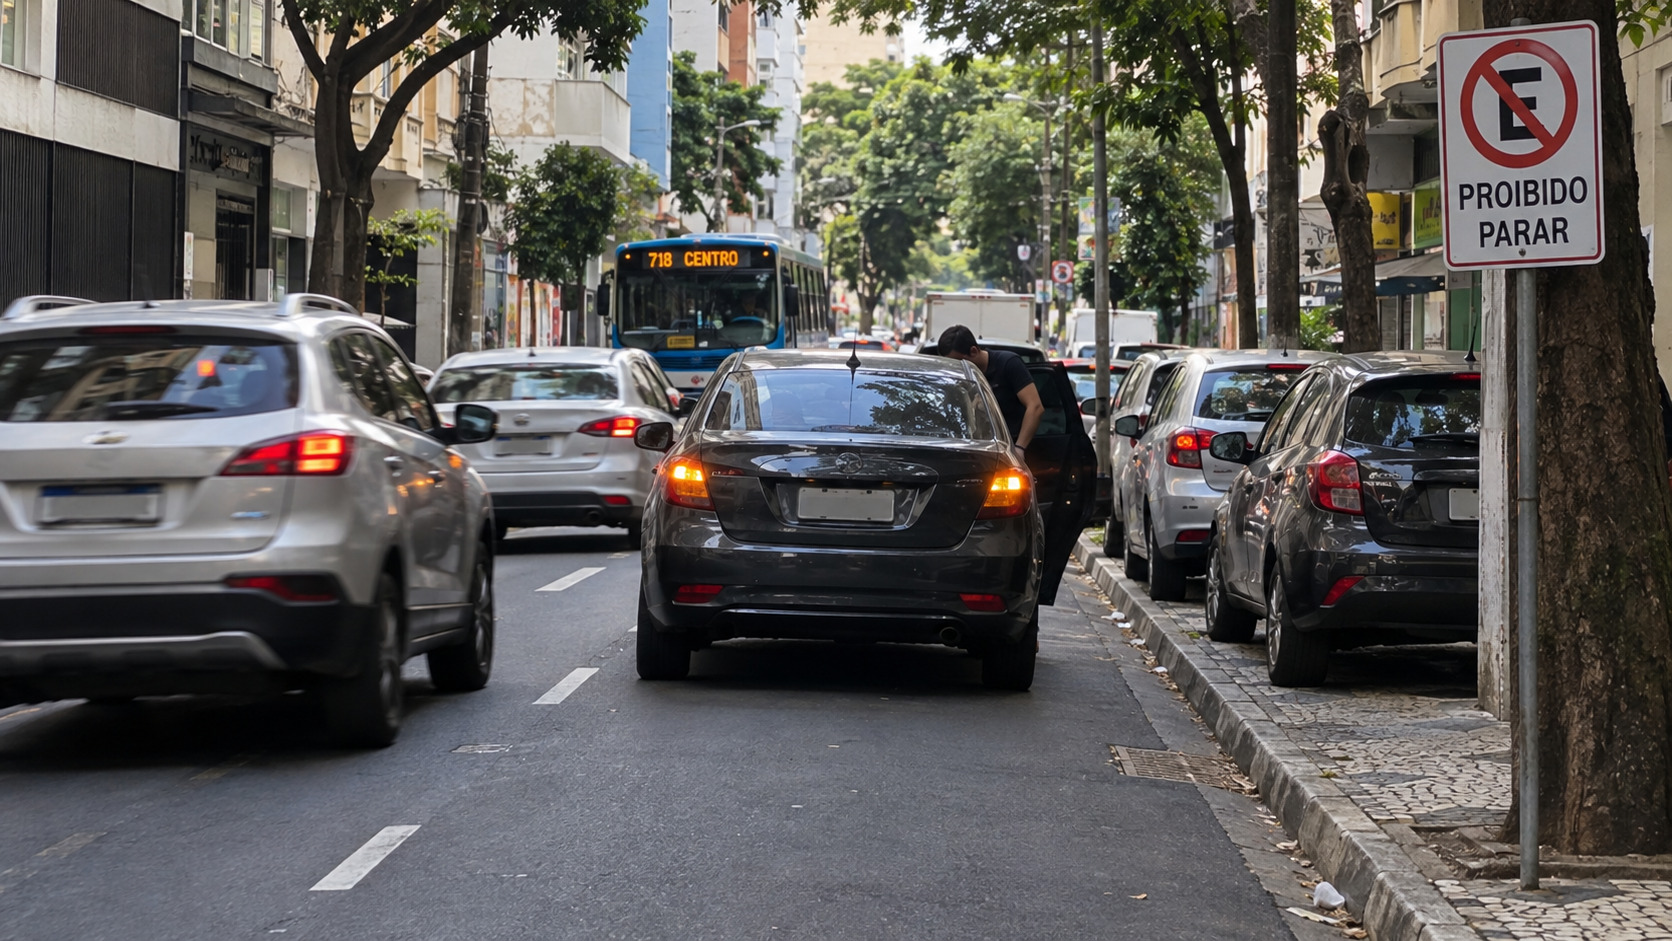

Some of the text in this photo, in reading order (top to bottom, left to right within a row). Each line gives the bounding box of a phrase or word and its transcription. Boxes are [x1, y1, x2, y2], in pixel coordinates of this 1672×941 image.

[1499, 66, 1544, 141] E
[1458, 176, 1588, 210] PROIBIDO
[1479, 216, 1570, 248] PARAR
[648, 250, 739, 268] 718 CENTRO
